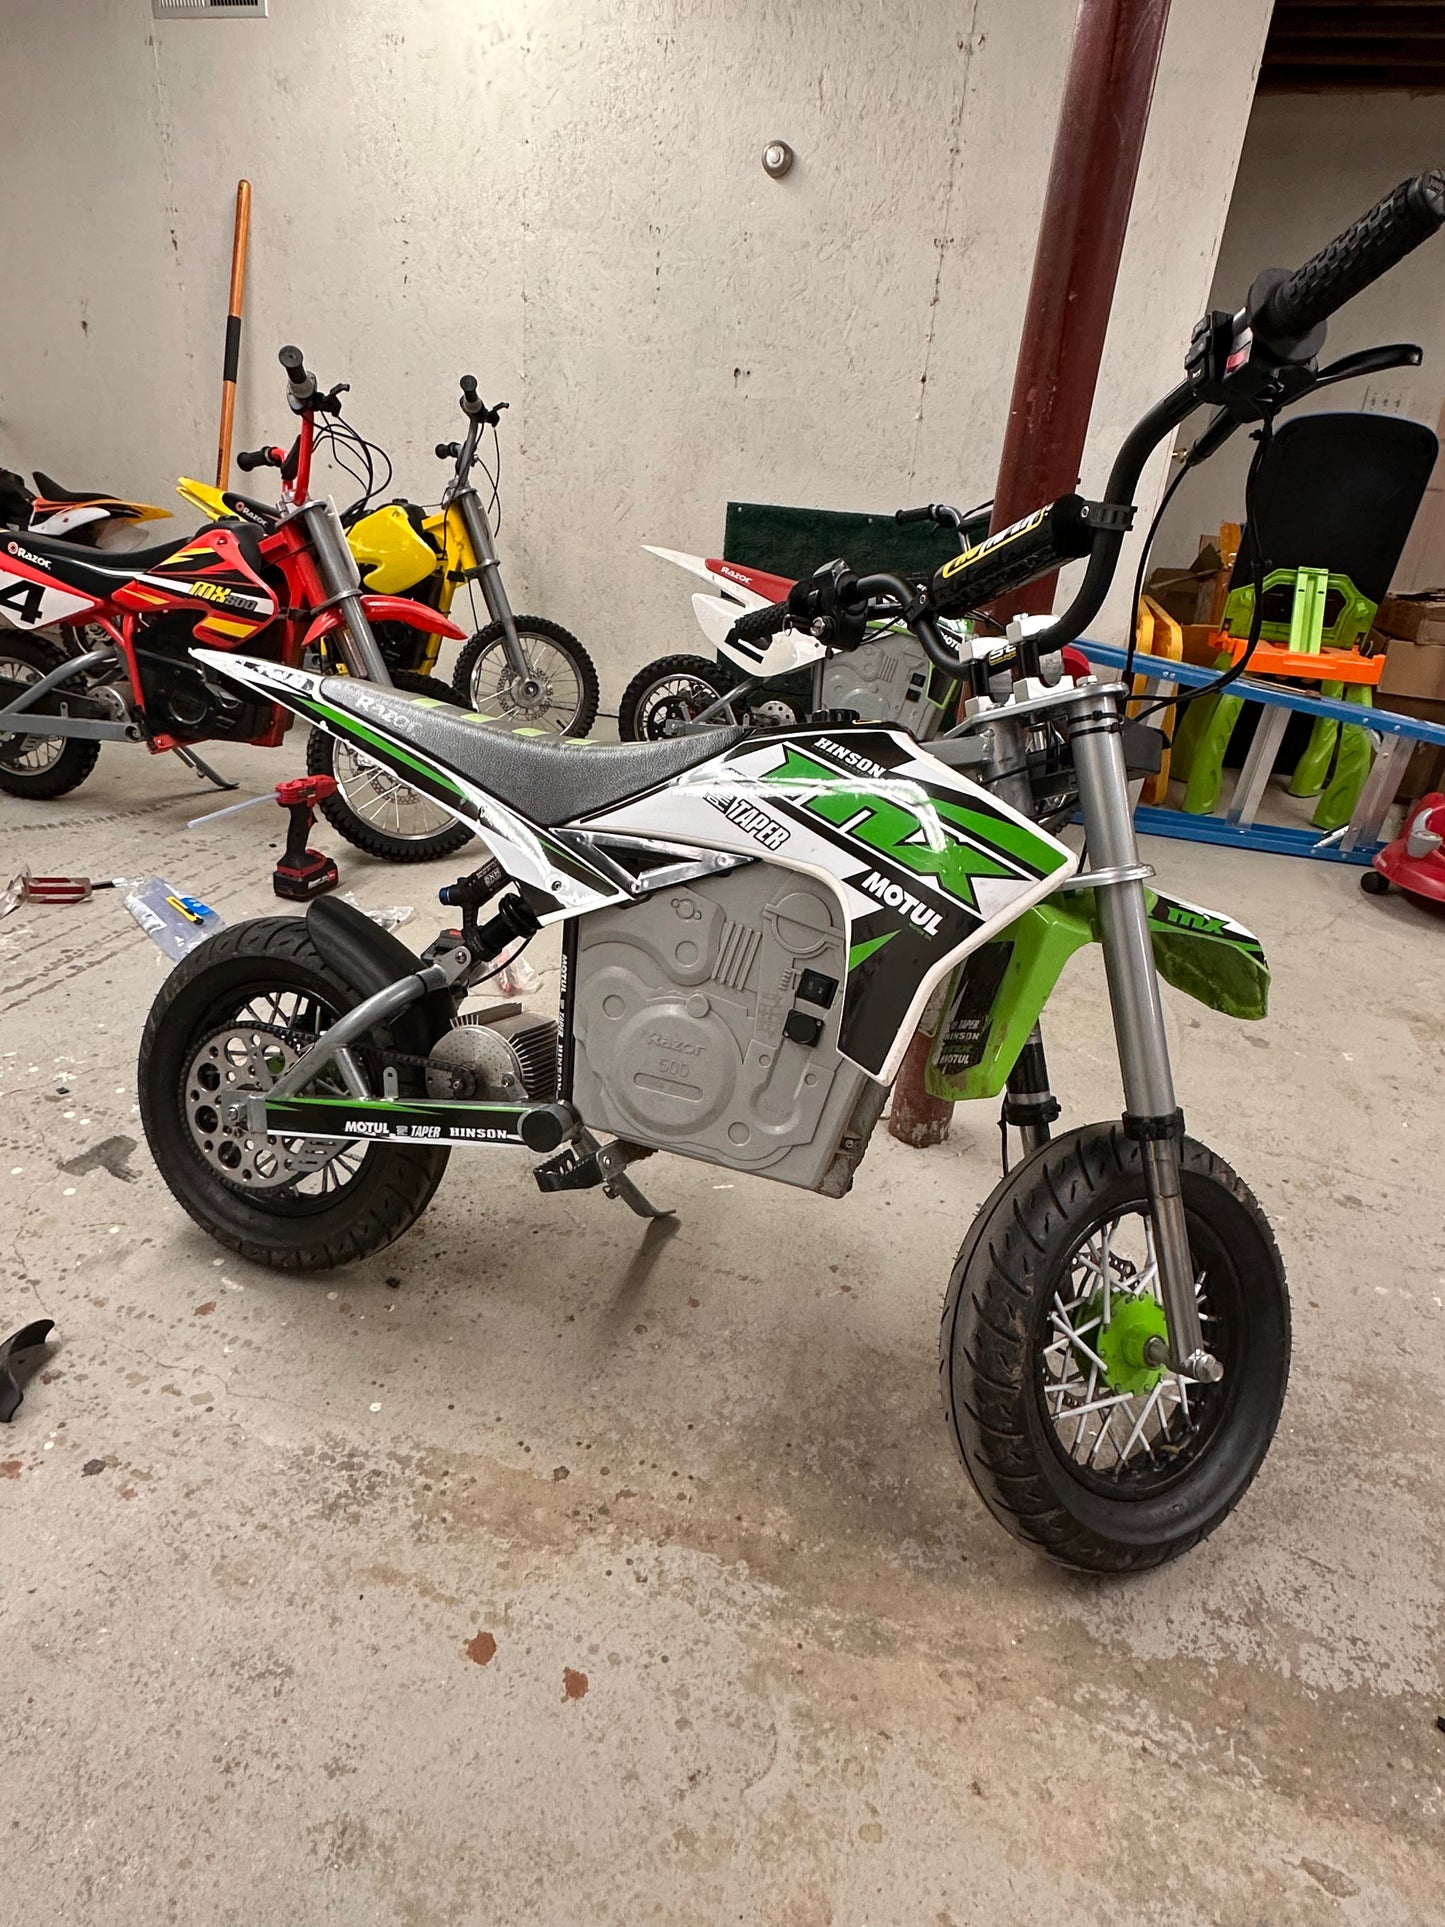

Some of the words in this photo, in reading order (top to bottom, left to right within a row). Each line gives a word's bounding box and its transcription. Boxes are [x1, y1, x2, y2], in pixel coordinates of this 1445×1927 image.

[18, 547, 52, 570] Razor
[720, 566, 753, 585] Razor
[0, 580, 46, 624] 4
[814, 737, 887, 778] HINSON
[725, 798, 791, 851] TAPER
[861, 871, 946, 937] MOTUL
[559, 953, 568, 993] MOTUL
[555, 1043, 564, 1092] HINSON
[939, 1054, 970, 1065] MOTUL
[344, 1120, 390, 1135] MOTUL
[410, 1125, 442, 1138] TAPER
[449, 1127, 507, 1139] HINSON
